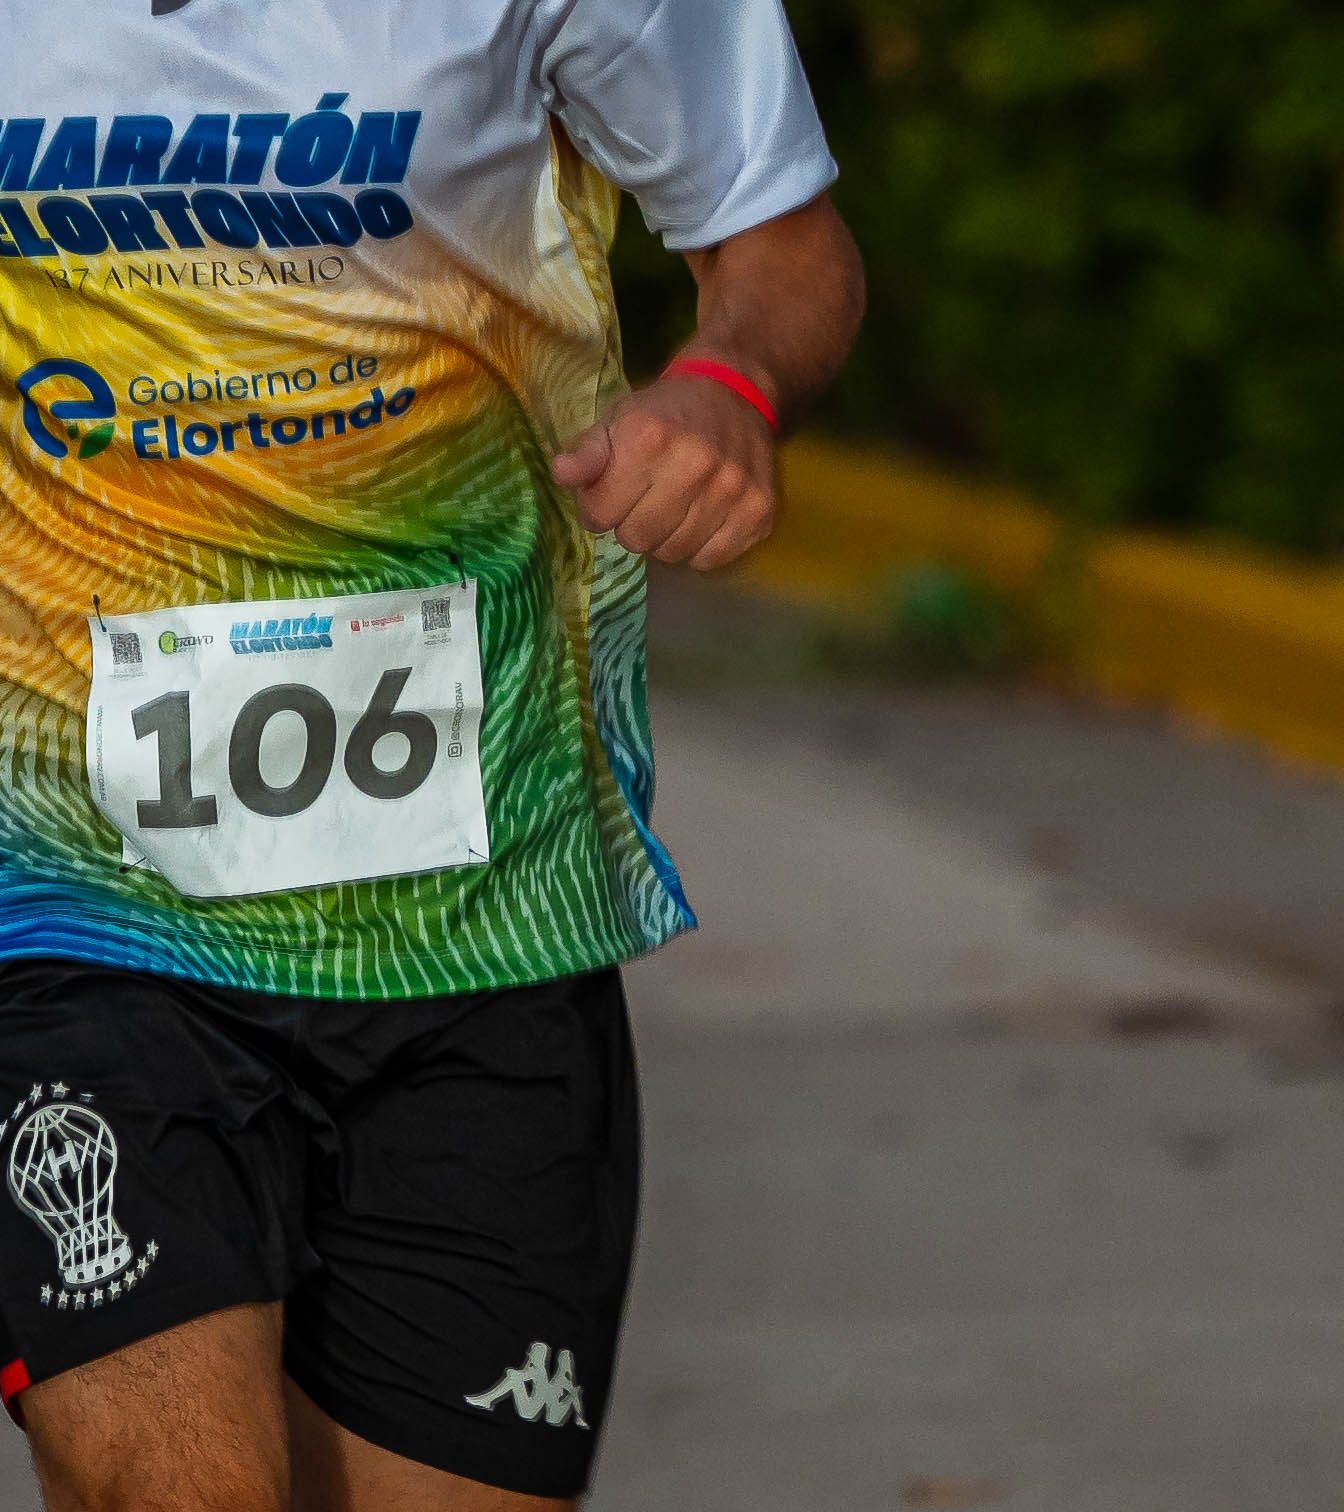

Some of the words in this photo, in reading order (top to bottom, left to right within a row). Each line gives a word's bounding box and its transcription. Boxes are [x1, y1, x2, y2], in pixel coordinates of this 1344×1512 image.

[104, 256, 344, 290] ANIVERSARIO
[128, 368, 318, 407] Gobierno
[328, 354, 379, 385] de
[132, 385, 416, 461] Elortondo
[131, 666, 438, 829] 106
